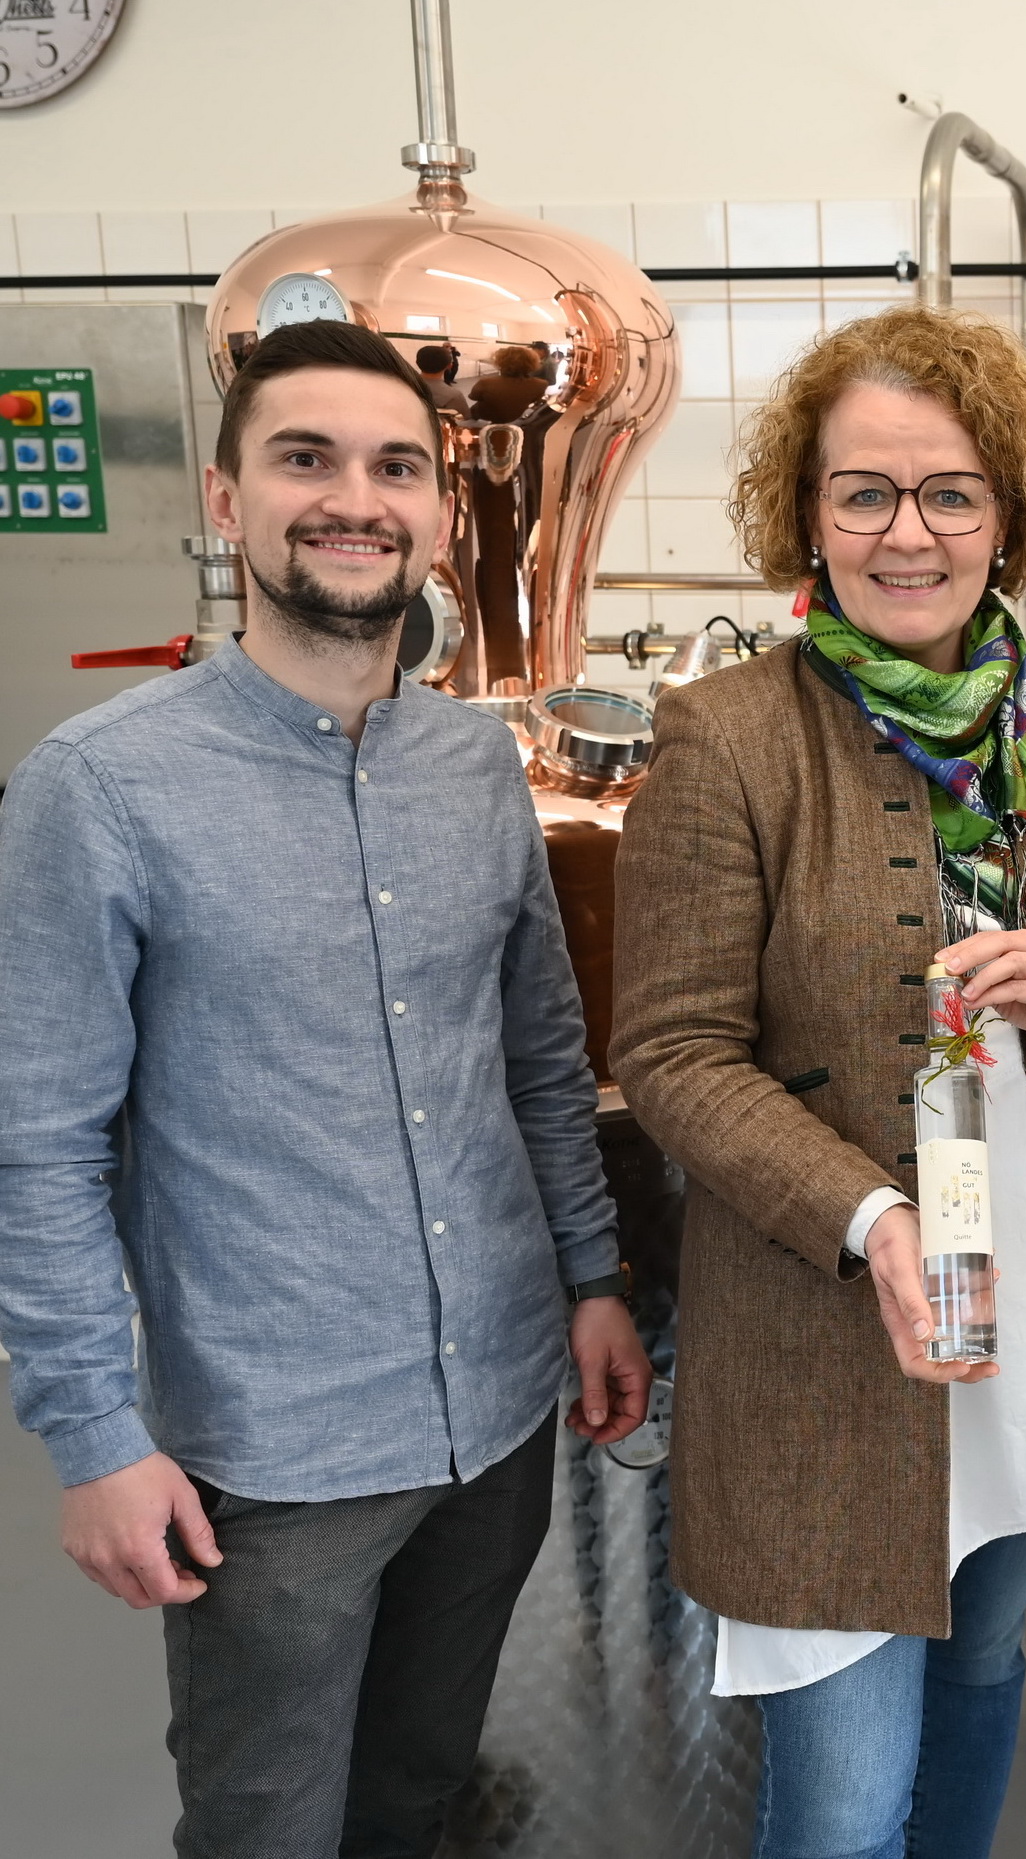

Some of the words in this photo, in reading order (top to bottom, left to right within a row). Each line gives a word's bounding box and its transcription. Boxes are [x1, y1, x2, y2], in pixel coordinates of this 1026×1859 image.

[35, 30, 59, 69] 5
[302, 292, 310, 302] 60
[285, 302, 294, 311] 40
[319, 300, 328, 309] 80
[961, 1169, 984, 1177] LANDES
[953, 1233, 973, 1241] Quitte
